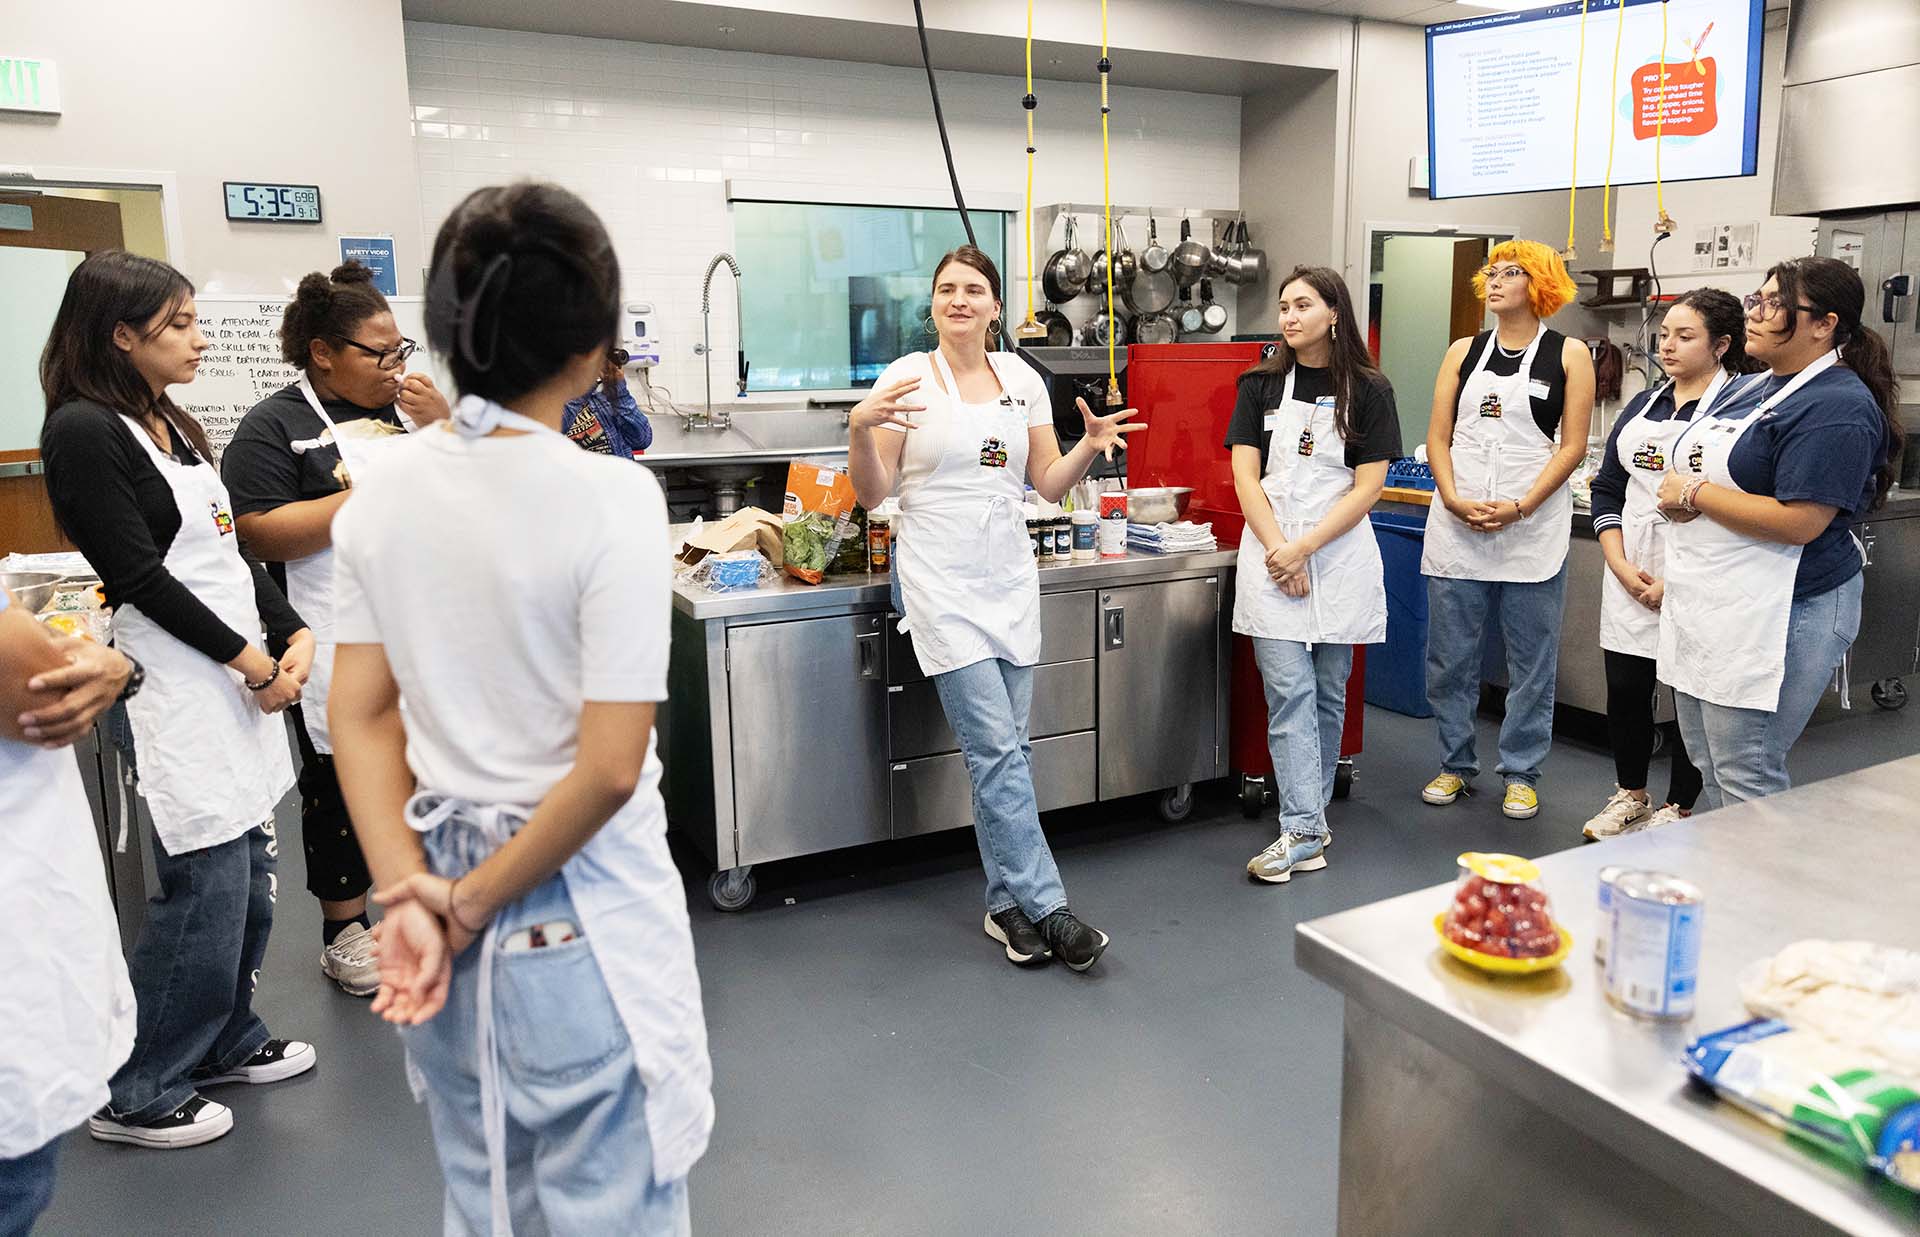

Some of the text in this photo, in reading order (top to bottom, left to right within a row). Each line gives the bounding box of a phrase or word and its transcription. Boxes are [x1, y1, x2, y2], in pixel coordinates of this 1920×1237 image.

[0, 59, 40, 104] XIT
[1680, 82, 1704, 90] tougher
[243, 187, 295, 217] 5:35
[259, 304, 282, 313] BASIC
[221, 317, 271, 327] ATTENDANCE
[221, 343, 244, 352] SKILL
